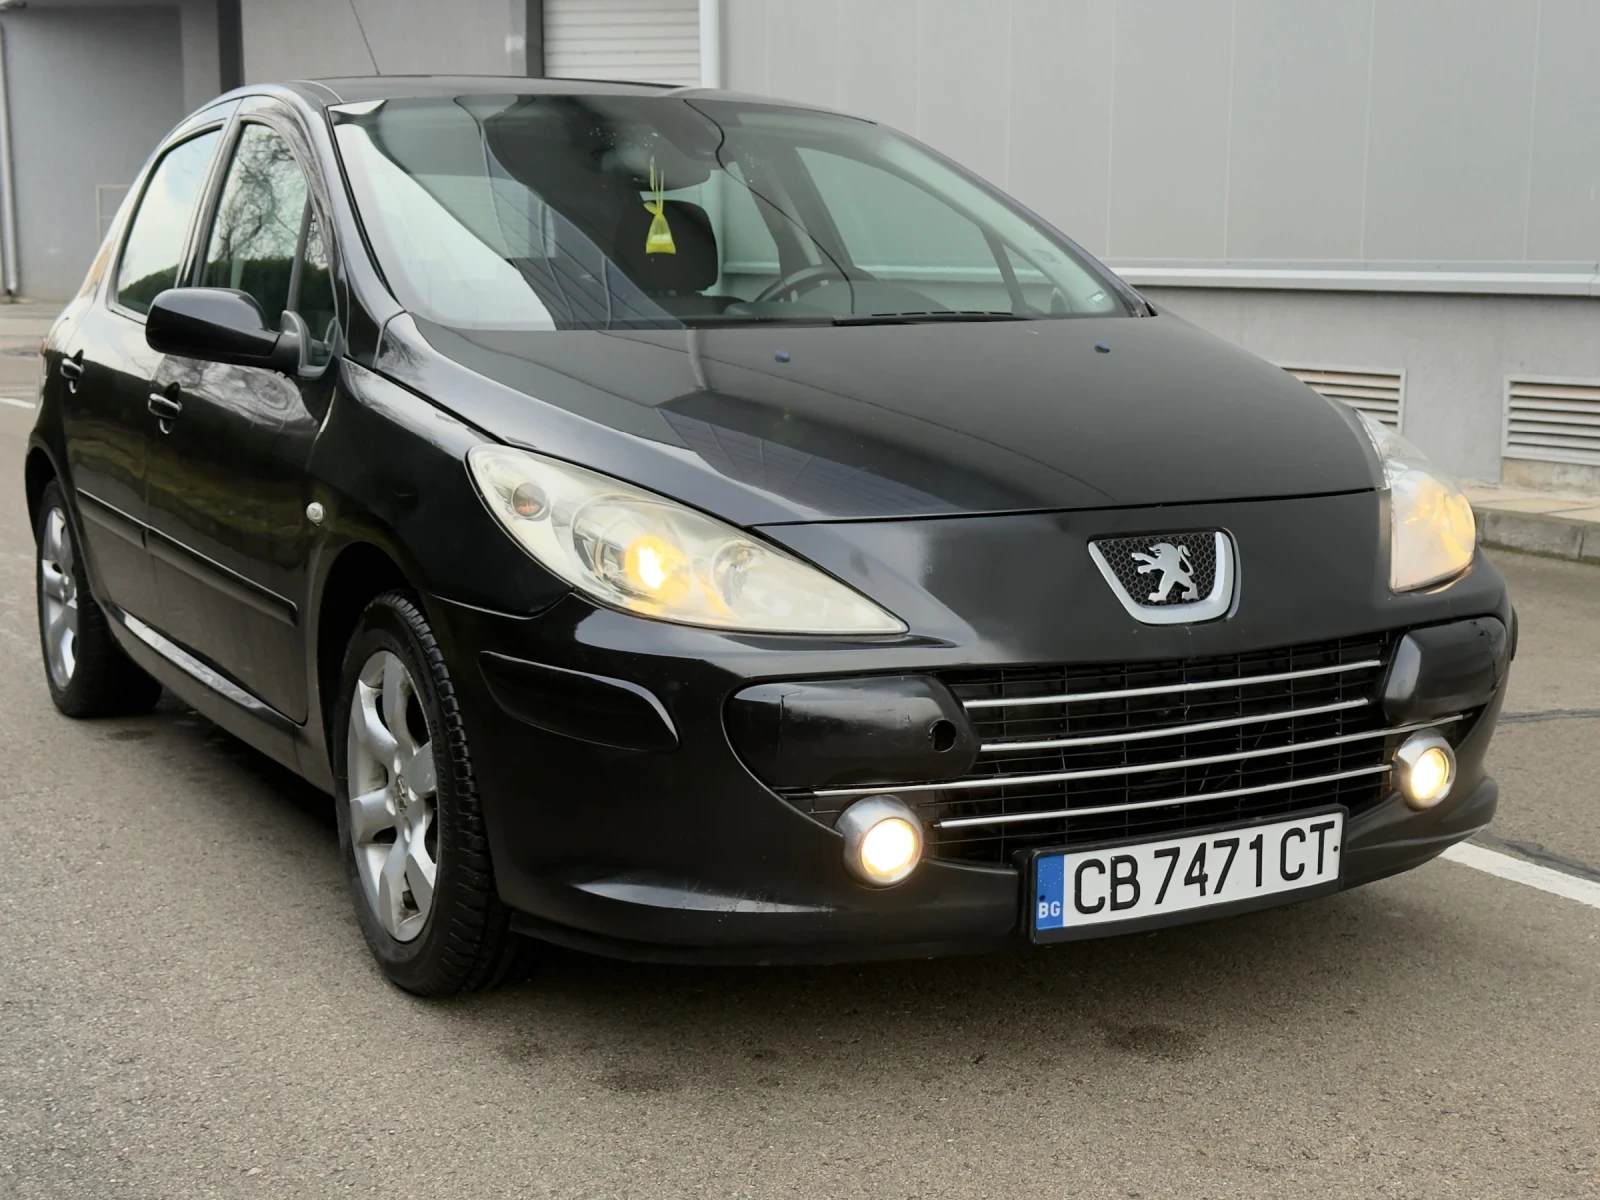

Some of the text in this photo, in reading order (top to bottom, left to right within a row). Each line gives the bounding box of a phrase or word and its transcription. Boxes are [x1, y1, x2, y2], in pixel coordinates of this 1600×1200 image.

[1074, 820, 1335, 914] CB 7471 CT
[1038, 900, 1061, 919] BG
